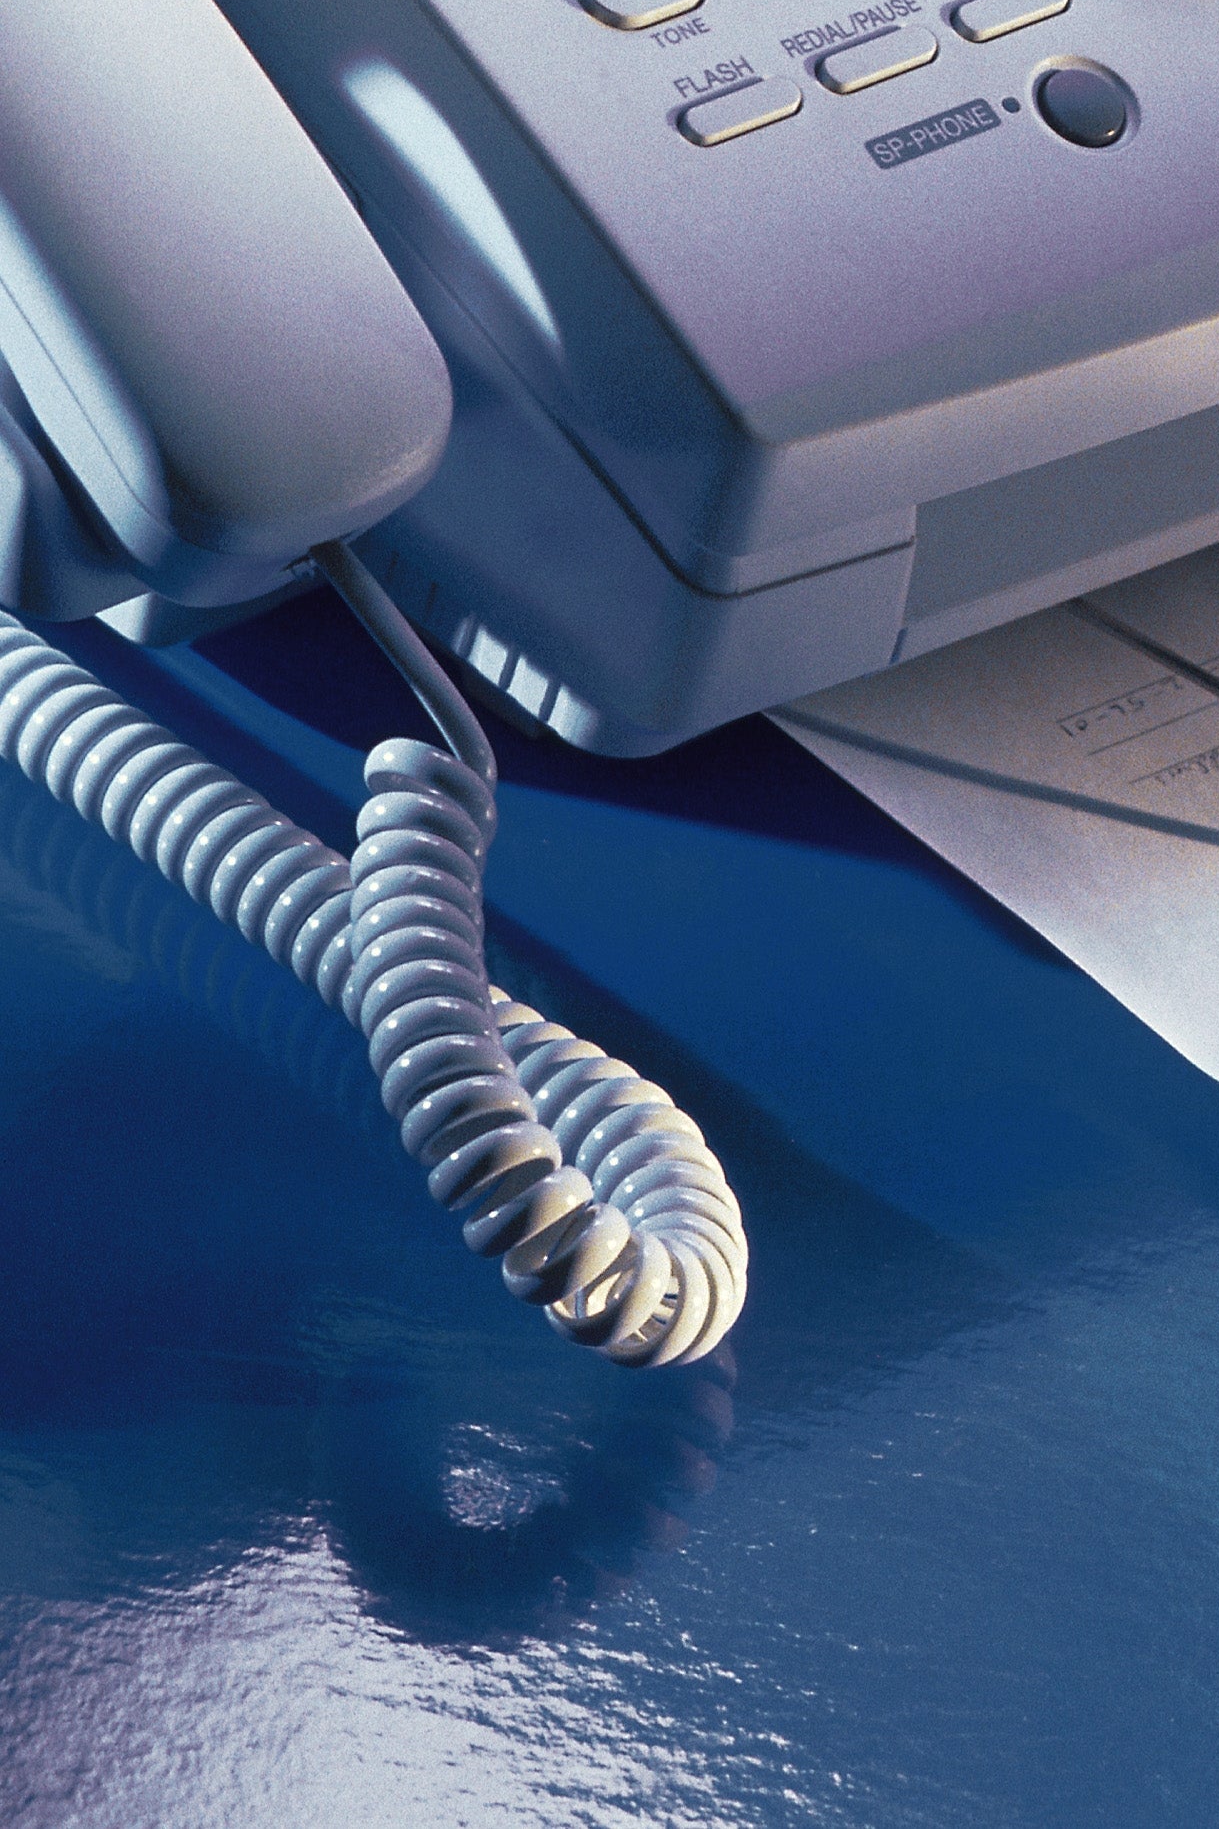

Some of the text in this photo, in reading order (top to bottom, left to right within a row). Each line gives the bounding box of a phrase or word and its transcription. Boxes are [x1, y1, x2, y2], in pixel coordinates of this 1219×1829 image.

[650, 17, 711, 49] TONE
[672, 55, 756, 98] FLASH
[872, 104, 995, 167] SP-PHONE
